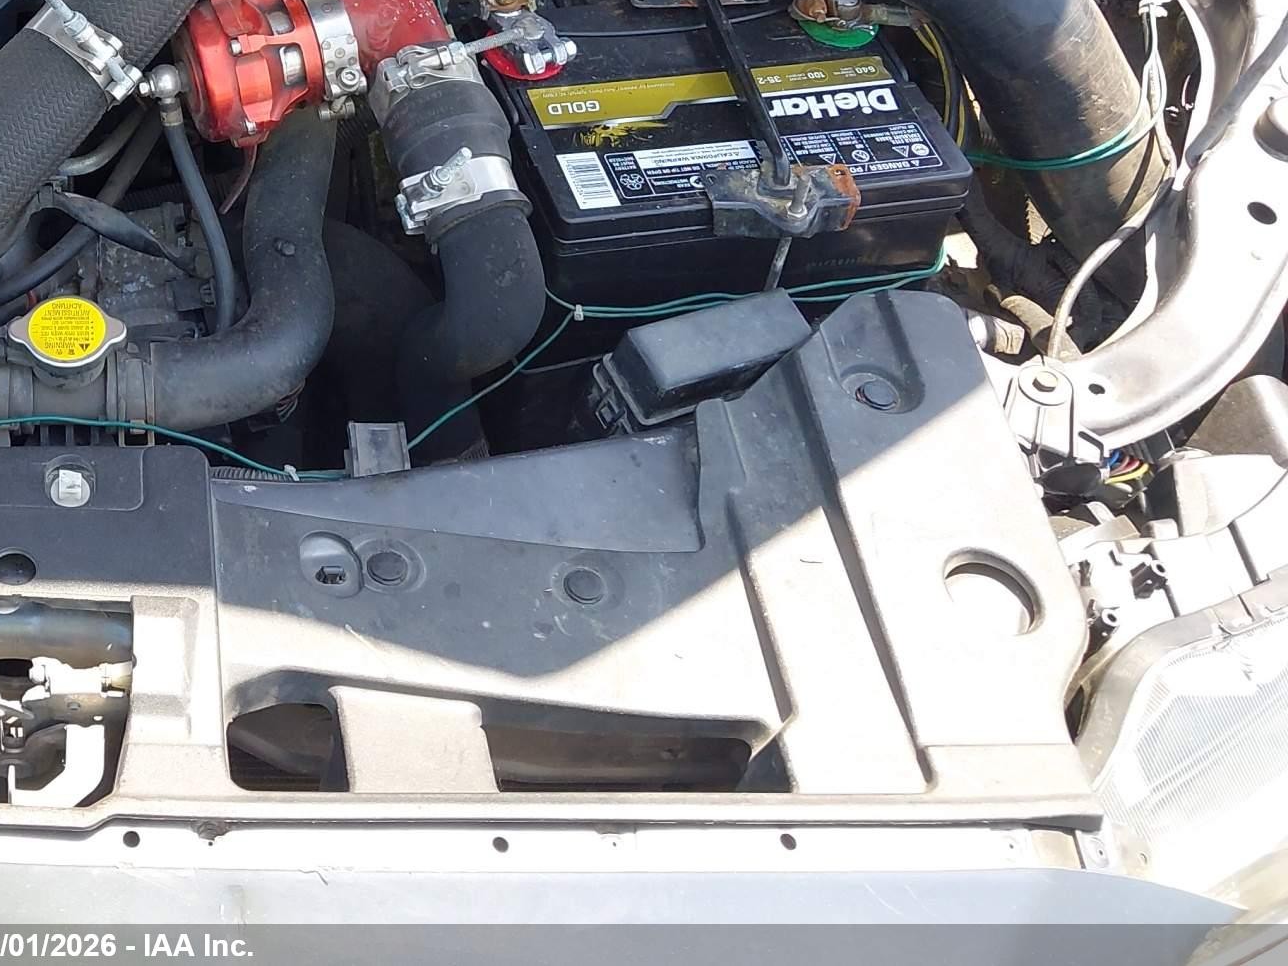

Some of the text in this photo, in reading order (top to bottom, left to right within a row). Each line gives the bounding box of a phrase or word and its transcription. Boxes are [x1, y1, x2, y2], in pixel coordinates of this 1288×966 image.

[855, 65, 876, 74] 640
[756, 75, 782, 84] 35-2
[807, 71, 826, 79] 100
[547, 100, 601, 115] GOLD
[768, 87, 898, 119] DieHar
[869, 161, 911, 171] DANGER
